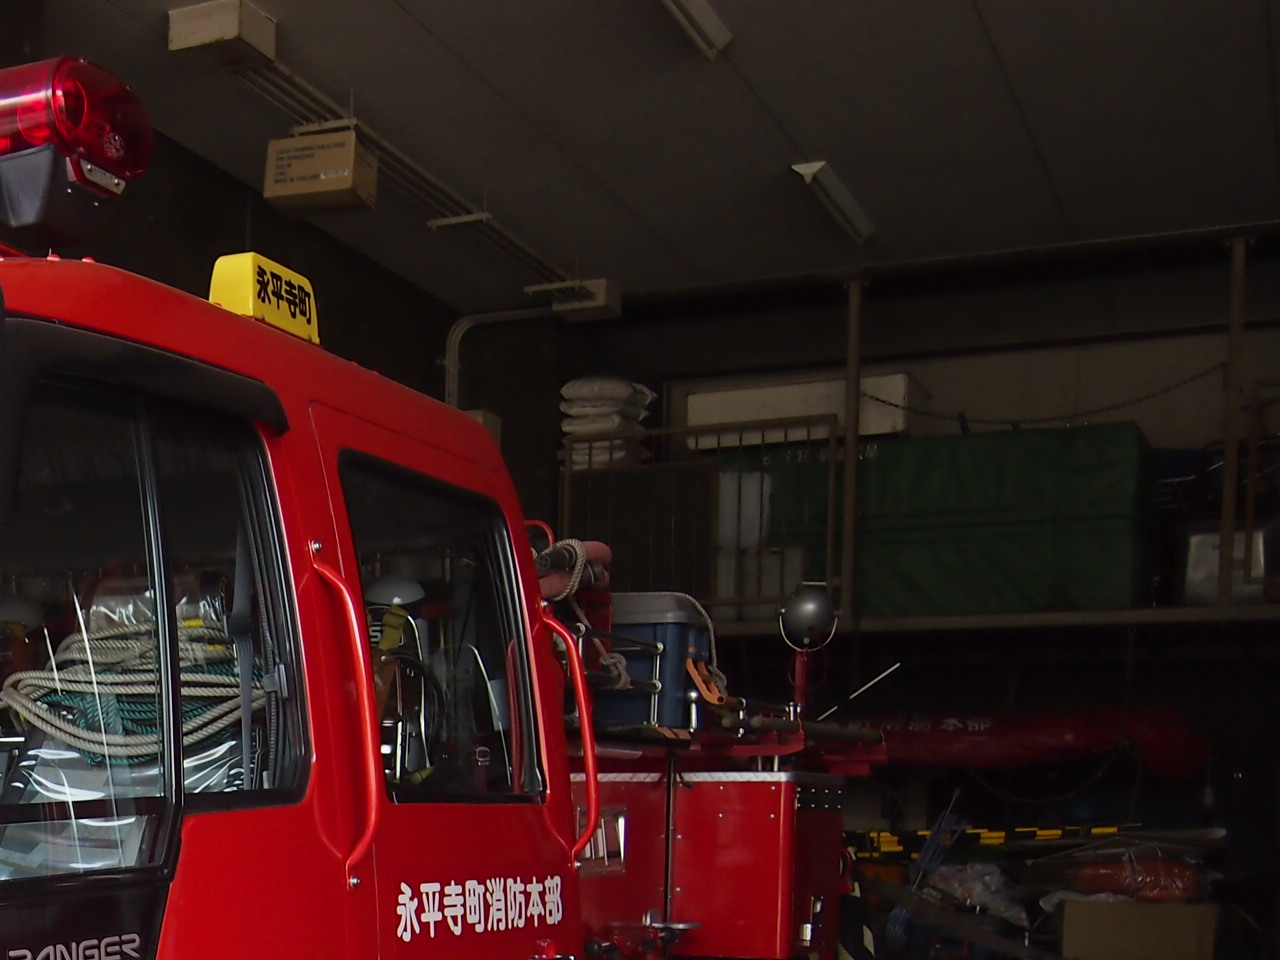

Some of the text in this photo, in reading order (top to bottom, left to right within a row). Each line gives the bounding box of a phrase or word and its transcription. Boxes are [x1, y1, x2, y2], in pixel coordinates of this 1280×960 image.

[256, 265, 311, 325] 永平寺町
[396, 875, 562, 942] 永平寺町消防本部
